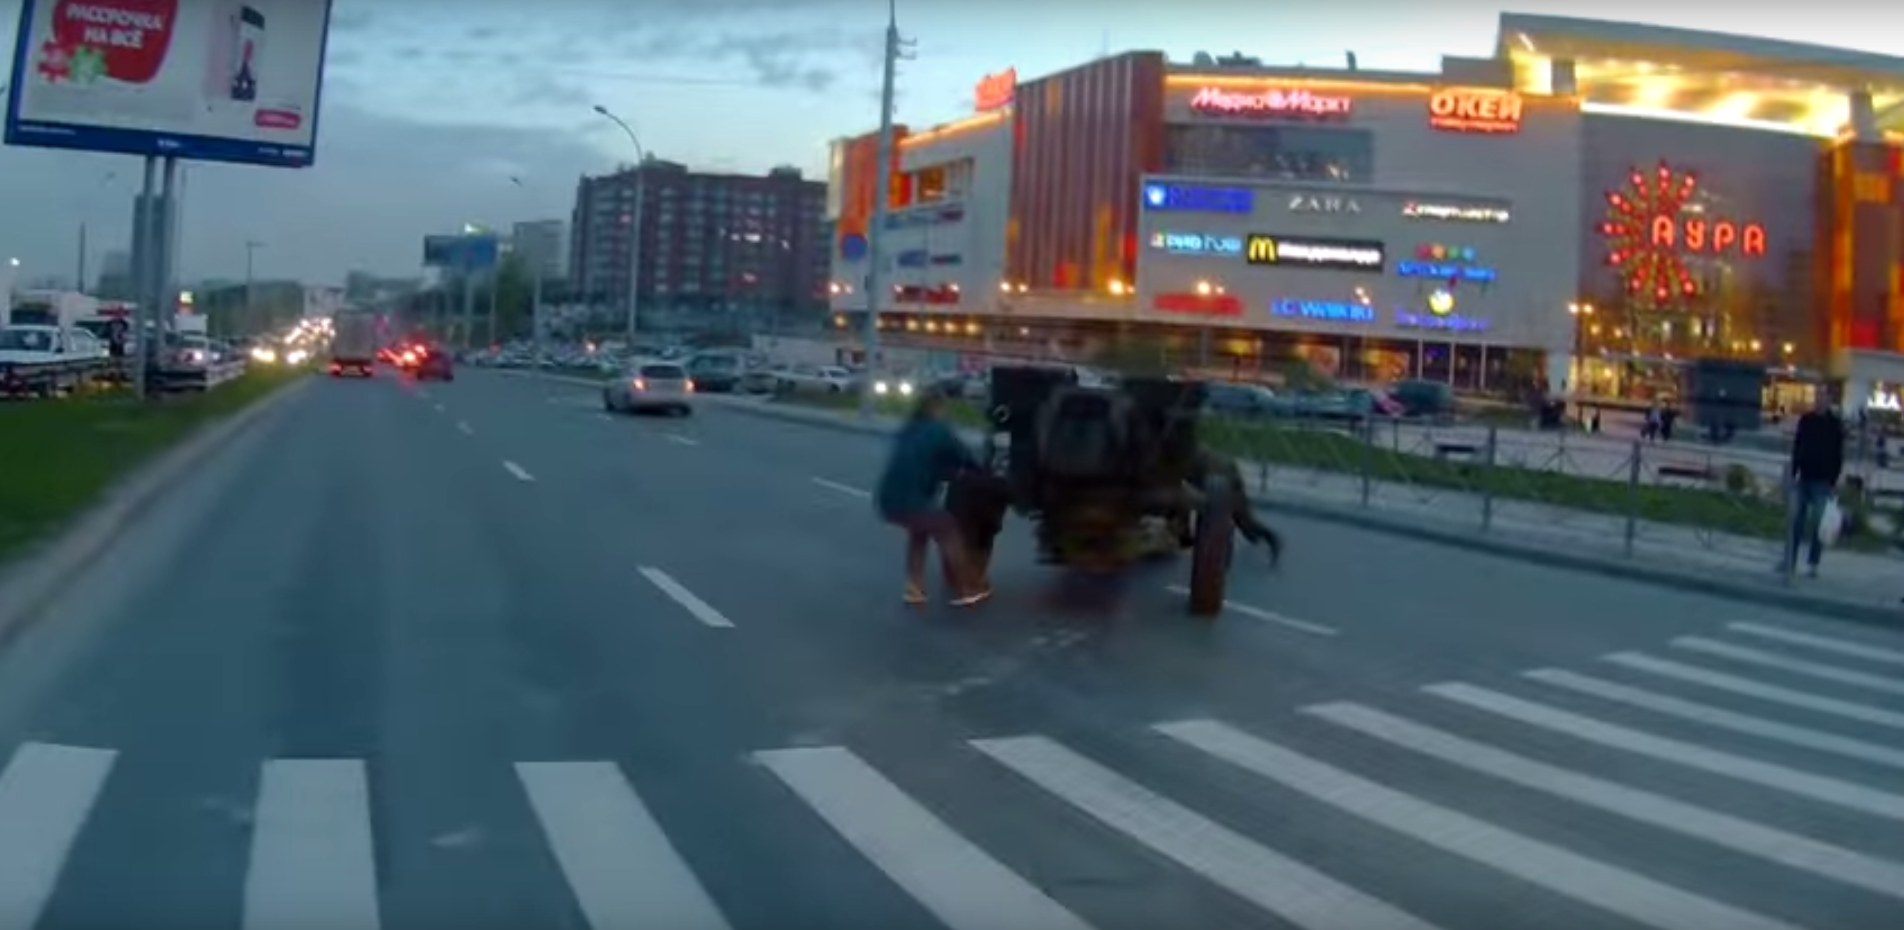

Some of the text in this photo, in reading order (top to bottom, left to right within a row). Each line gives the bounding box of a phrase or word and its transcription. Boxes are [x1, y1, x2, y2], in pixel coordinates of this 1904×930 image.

[67, 3, 163, 30] РАССРОЧКА
[85, 26, 107, 42] НА
[1288, 195, 1361, 214] ZARA
[1652, 215, 1767, 256] АУРА
